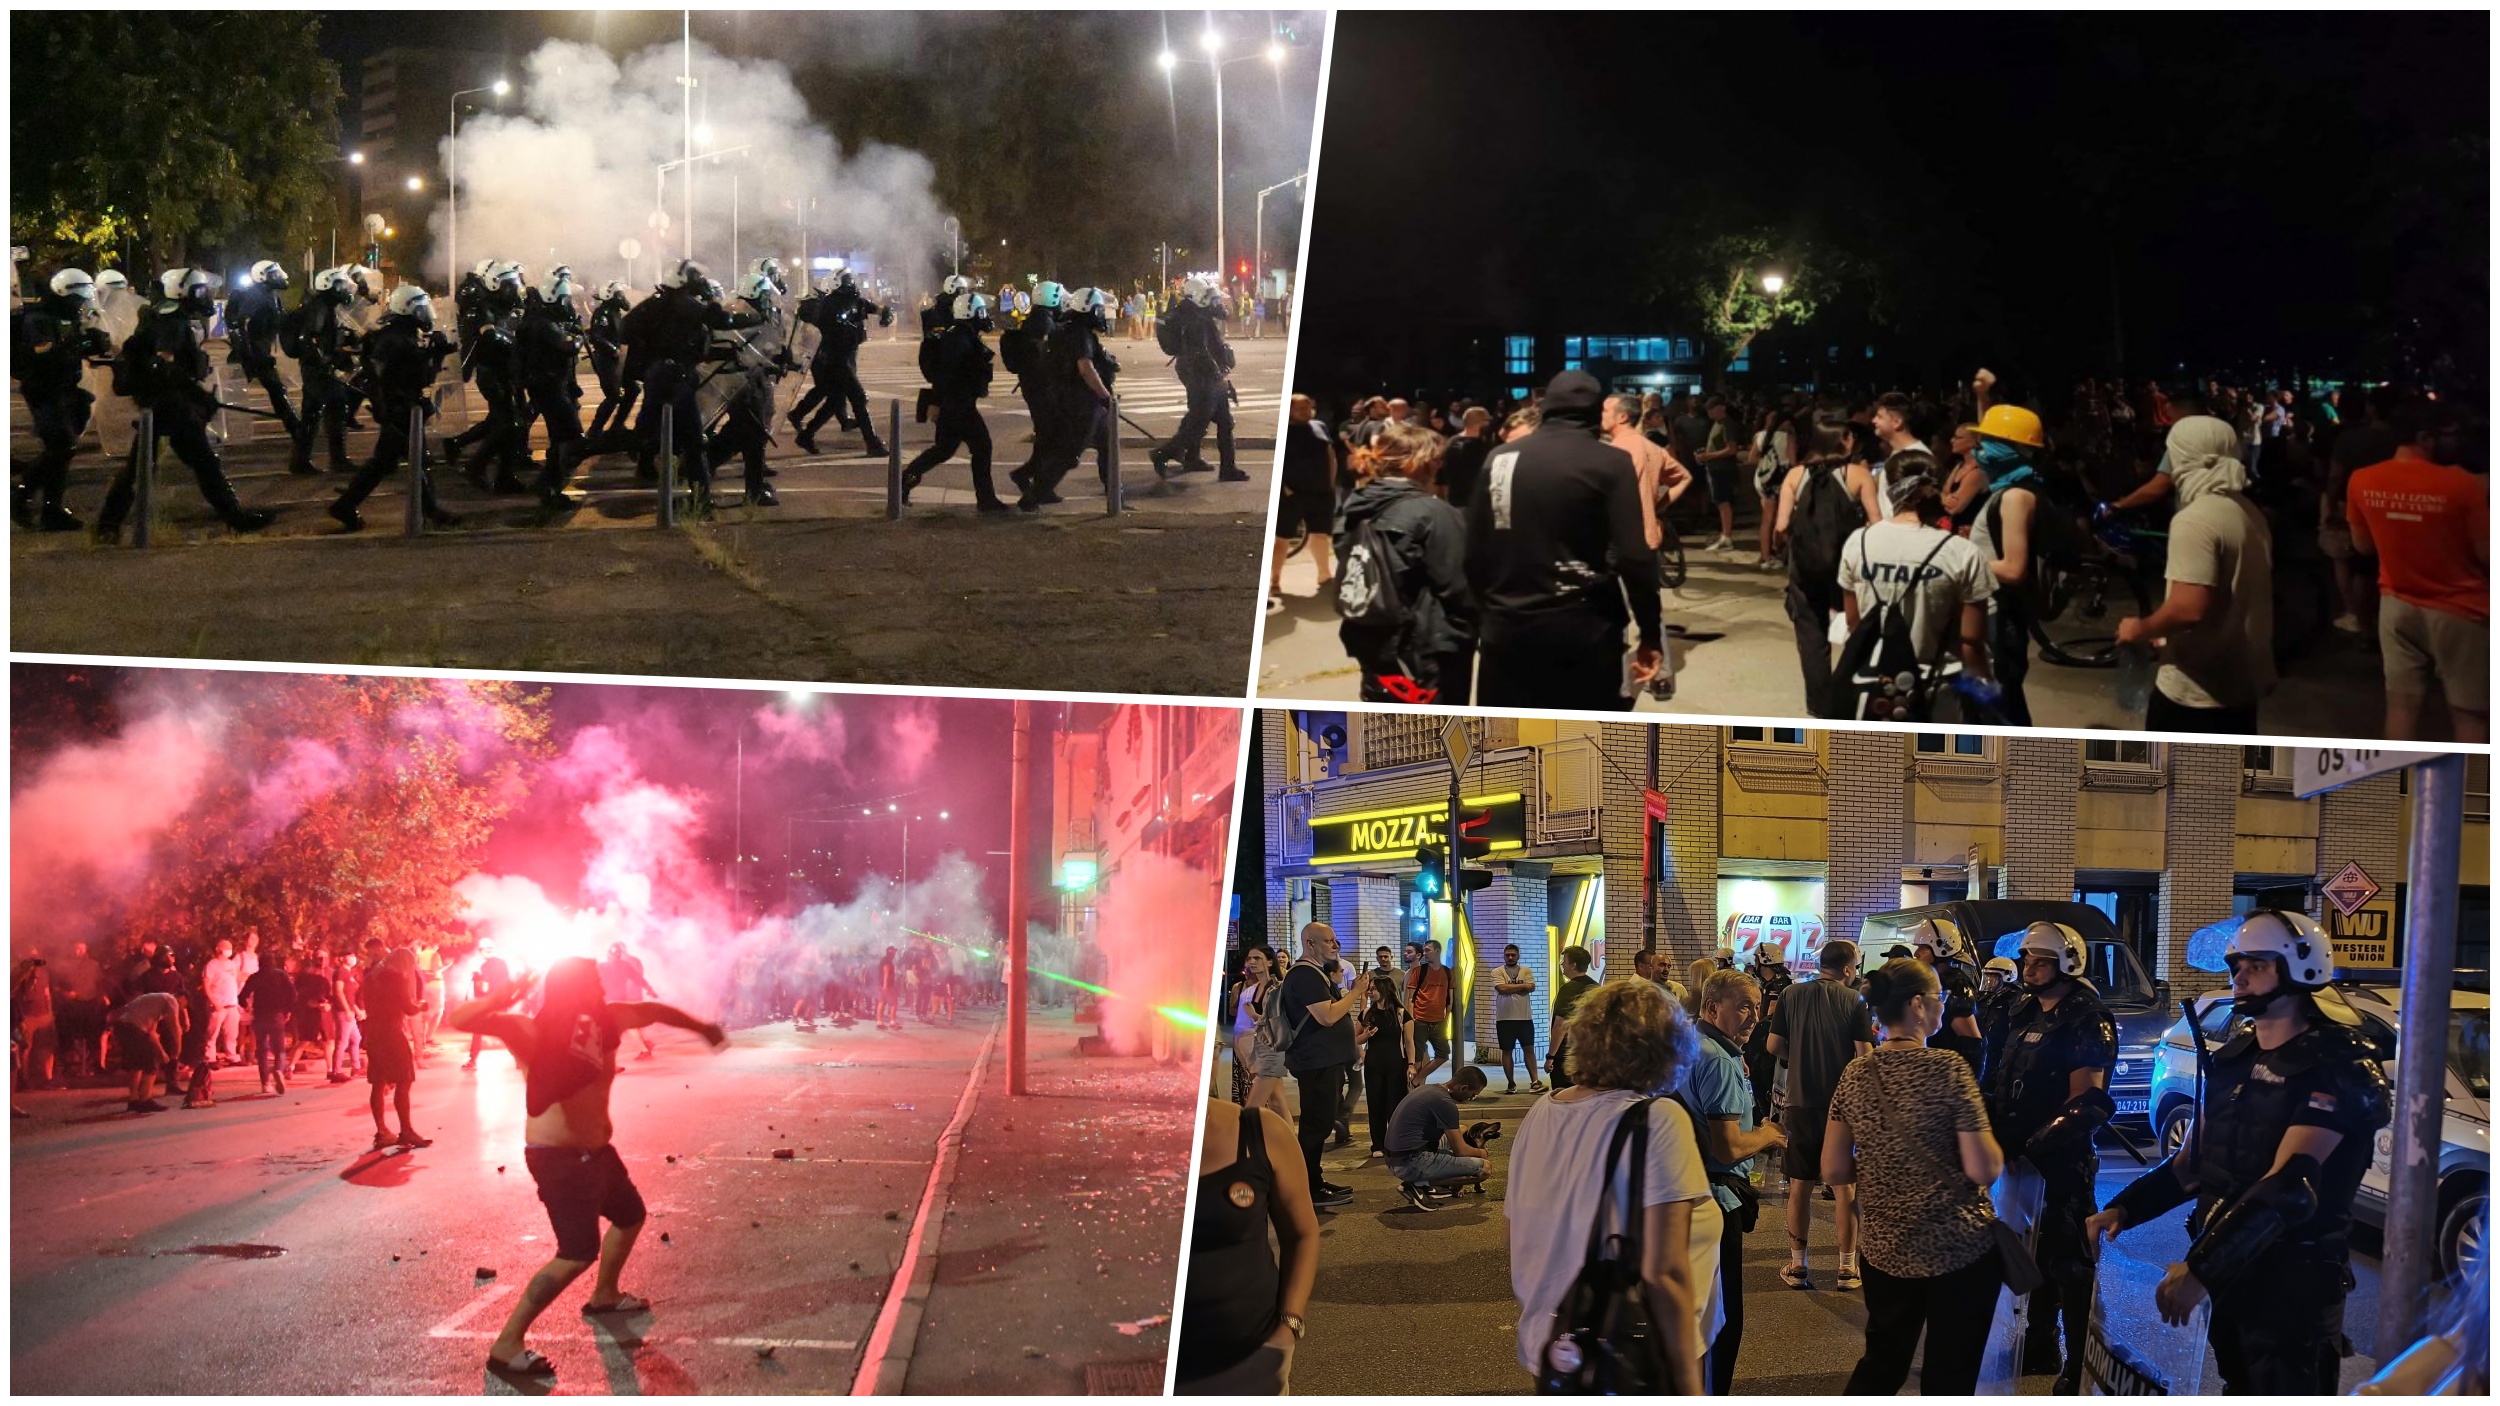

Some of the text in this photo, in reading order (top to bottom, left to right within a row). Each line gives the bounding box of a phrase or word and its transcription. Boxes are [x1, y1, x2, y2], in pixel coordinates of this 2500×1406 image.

[2363, 489, 2446, 503] VISUALIZING
[2365, 499, 2443, 513] THE FUTURE
[1351, 812, 1449, 851] MOZZAR
[1744, 915, 1760, 923] BAR
[1772, 917, 1790, 925] BAR
[2334, 912, 2382, 937] WU
[1802, 922, 1821, 948] 7
[2332, 943, 2386, 953] WESTERN
[2349, 953, 2385, 962] UNION
[2116, 1100, 2147, 1111] 047-219
